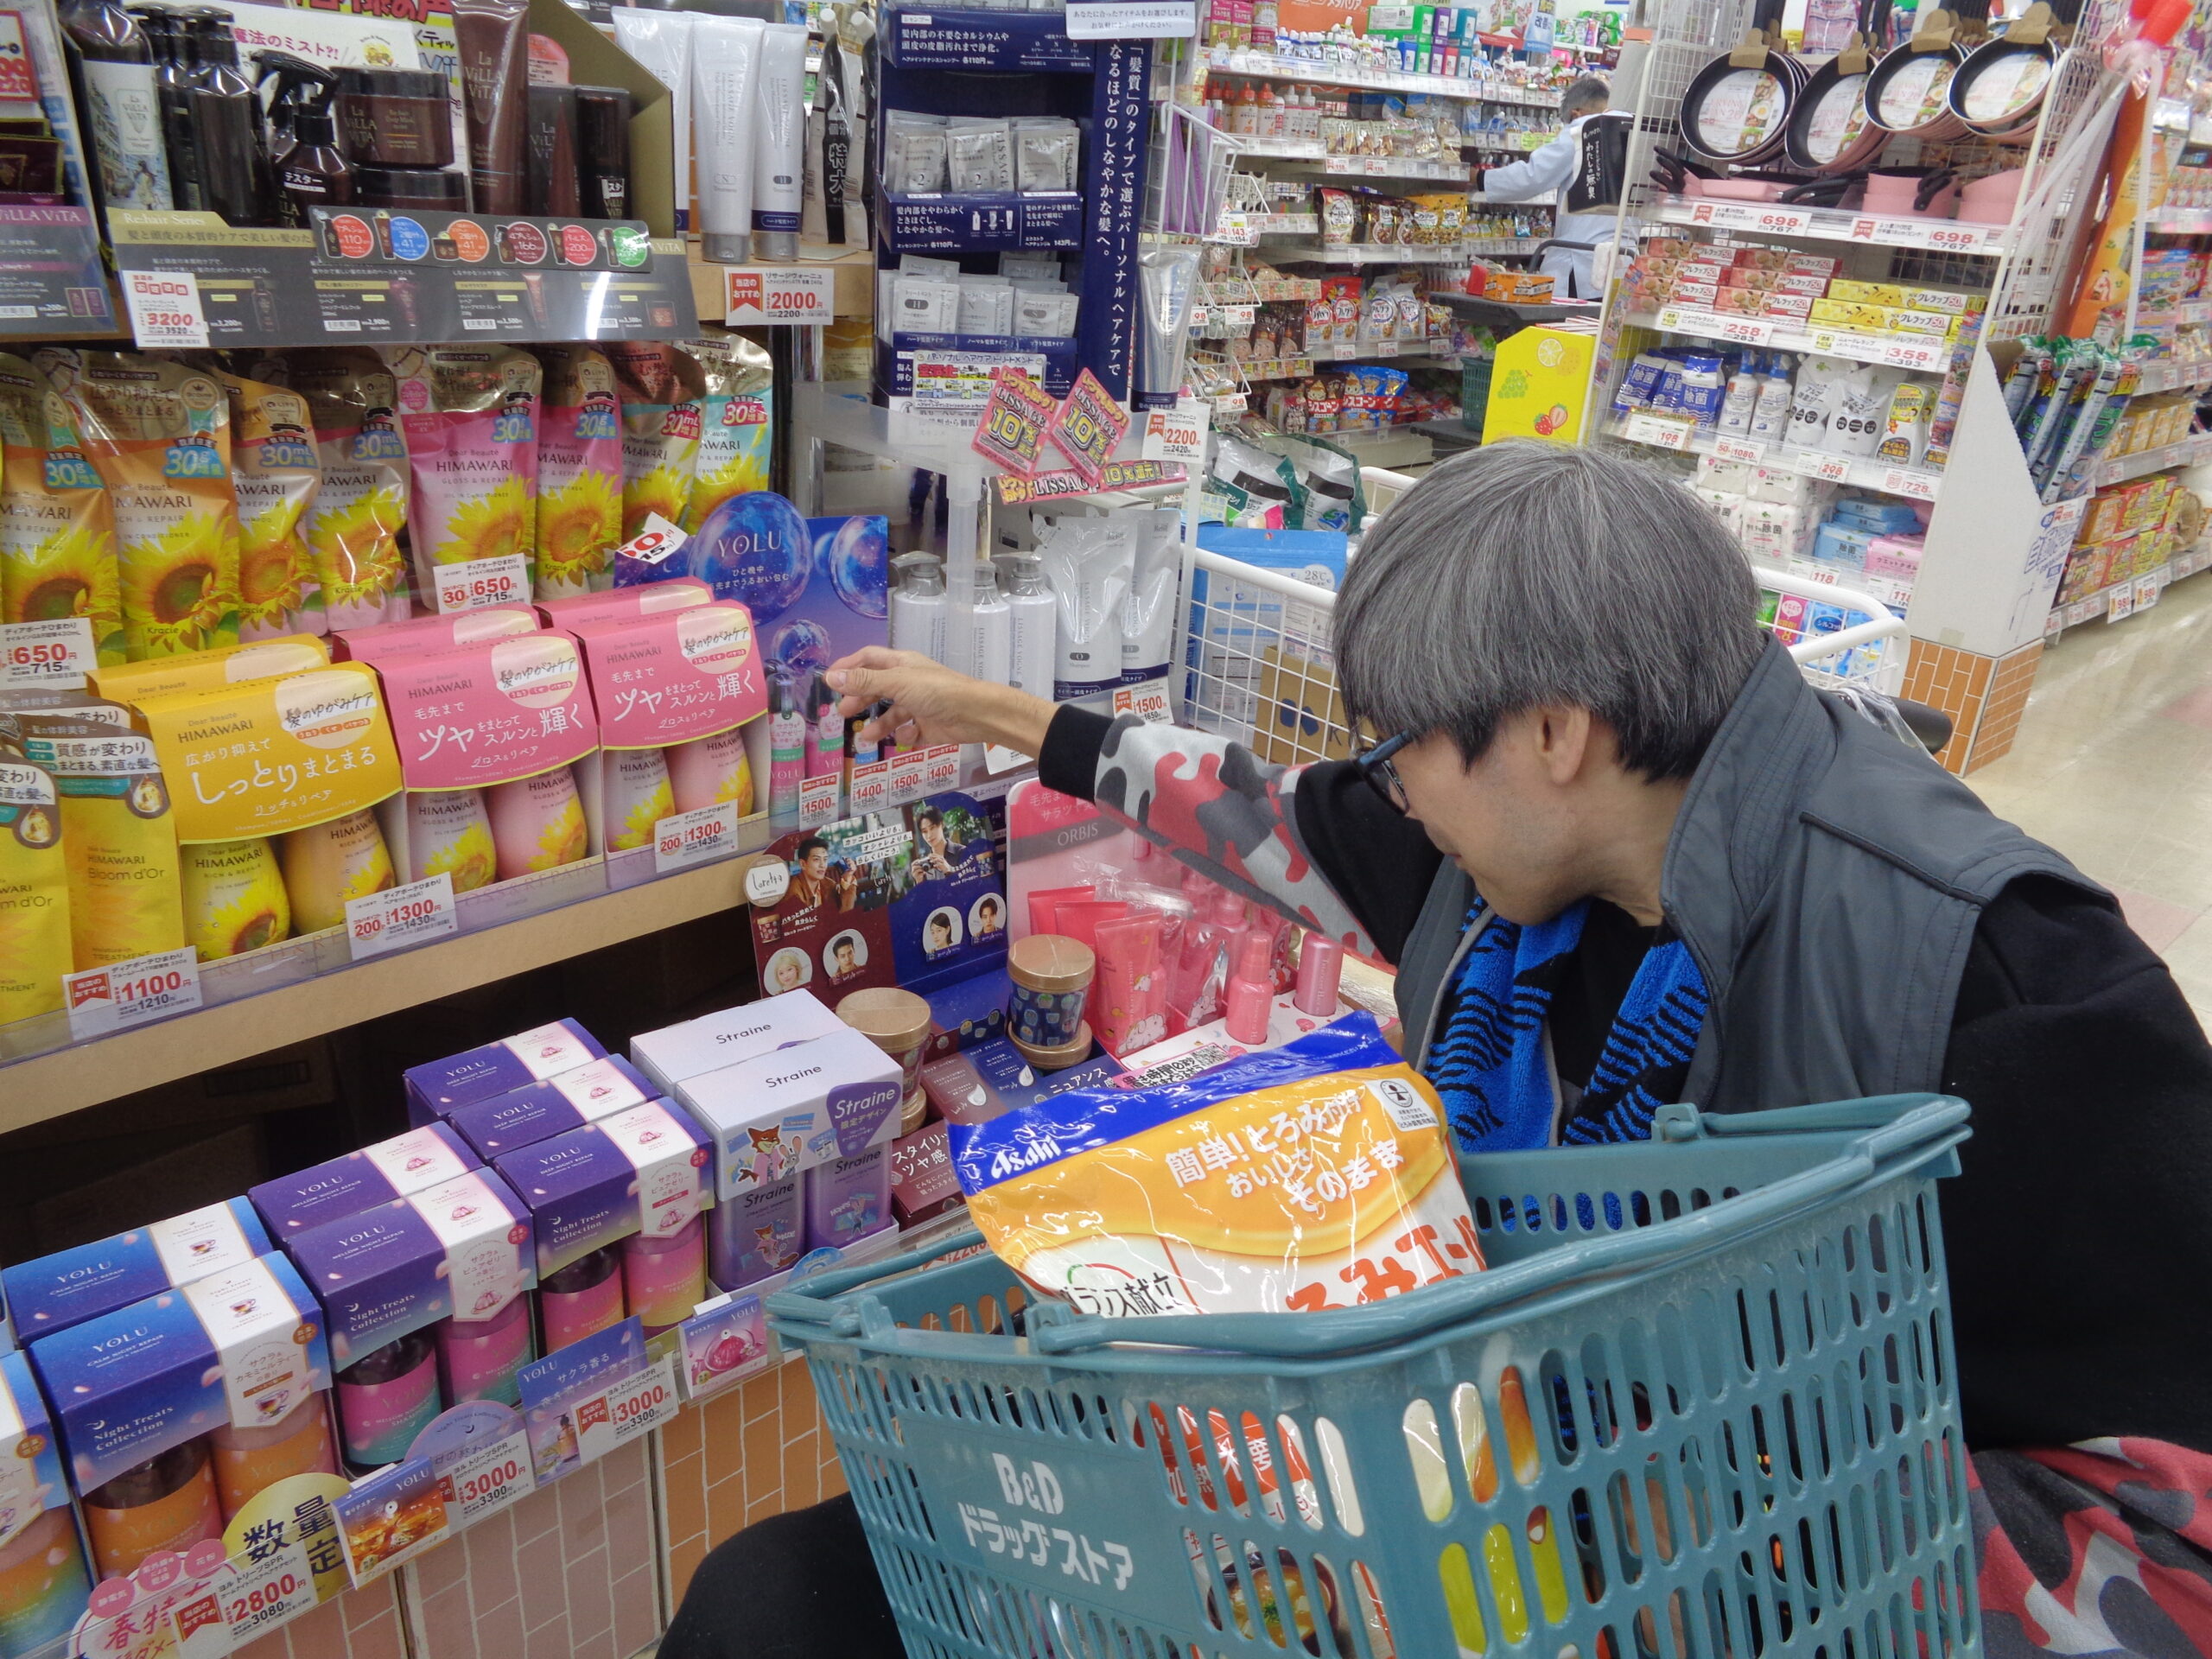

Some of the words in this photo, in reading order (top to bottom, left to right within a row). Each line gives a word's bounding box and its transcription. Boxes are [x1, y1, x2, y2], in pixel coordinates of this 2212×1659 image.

[830, 143, 848, 194] 特大
[1918, 294, 1948, 303] クレラップ
[147, 313, 193, 326] 3200
[1900, 315, 1931, 325] クレラップ
[1632, 371, 1655, 385] 除菌
[996, 387, 1046, 428] LISSAGE
[1308, 401, 1340, 412] シスコーン
[1684, 391, 1707, 404] 除菌
[1075, 387, 1116, 439] LISSAGE
[435, 460, 514, 473] HIMAWARI
[717, 530, 782, 556] YOLU
[1840, 543, 1856, 554] 除菌
[733, 565, 765, 577] ひと晩中
[684, 625, 749, 656] 髪のゆがみケア
[607, 646, 662, 664] HIMAWARI
[499, 657, 576, 690] 髪のゆがみケア
[612, 667, 654, 683] 毛先まで
[408, 680, 473, 699] HIMAWARI
[613, 688, 663, 722] ツヤ
[665, 679, 702, 697] をまとって
[670, 690, 715, 710] スルンと
[717, 670, 756, 703] 輝く
[285, 691, 373, 729] 髪のゆがみケア
[415, 702, 464, 720] 毛先まで
[178, 720, 253, 743] HIMAWARI
[485, 728, 538, 747] スルンと
[539, 703, 583, 738] 輝く
[56, 742, 146, 758] 質感が変わり
[418, 725, 474, 761] ツヤ
[478, 716, 520, 733] をまとって
[186, 738, 271, 766] 広がり抑えて
[59, 760, 162, 772] まとまる、素直な髪へ
[192, 746, 376, 804] しっとりまとまる
[1058, 823, 1098, 846] ORBIS
[87, 855, 145, 865] HIMAWARI
[88, 866, 131, 880] Bloom
[135, 866, 164, 880] d'Or
[716, 1023, 772, 1046] Straine
[447, 1061, 486, 1078] YOLU
[766, 1065, 823, 1089] Straine
[1050, 1068, 1108, 1094] ニュアンス
[493, 1103, 535, 1121] YOLU
[835, 1088, 896, 1121] Straine
[840, 1109, 887, 1129] 限定デザイン
[540, 1147, 582, 1166] YOLU
[835, 1150, 881, 1175] Straine
[901, 1149, 948, 1177] ツヤ感
[991, 1134, 1063, 1180] Asahi
[1226, 1147, 1316, 1199] おいしさ
[1286, 1137, 1405, 1213] そのまま
[297, 1175, 343, 1197] YOLU
[744, 1183, 795, 1208] Straine
[552, 1218, 575, 1235] Night
[576, 1209, 610, 1226] Treats
[553, 1221, 603, 1244] Collection
[338, 1225, 386, 1248] YOLU
[57, 1262, 111, 1284] YOLU
[350, 1307, 376, 1324] Night
[378, 1294, 416, 1312] Treats
[350, 1306, 408, 1332] Collection
[731, 1306, 759, 1321] YOLU
[92, 1326, 149, 1354] YOLU
[235, 1352, 299, 1383] カモミールティー
[523, 1360, 558, 1383] YOLU
[557, 1353, 610, 1383] サクラ香る
[93, 1423, 131, 1442] Night
[132, 1405, 175, 1427] Treats
[95, 1419, 164, 1452] Collection
[395, 1466, 430, 1492] YOLU
[992, 1452, 1065, 1515] B&D
[957, 1502, 1134, 1591] ドラッグストア
